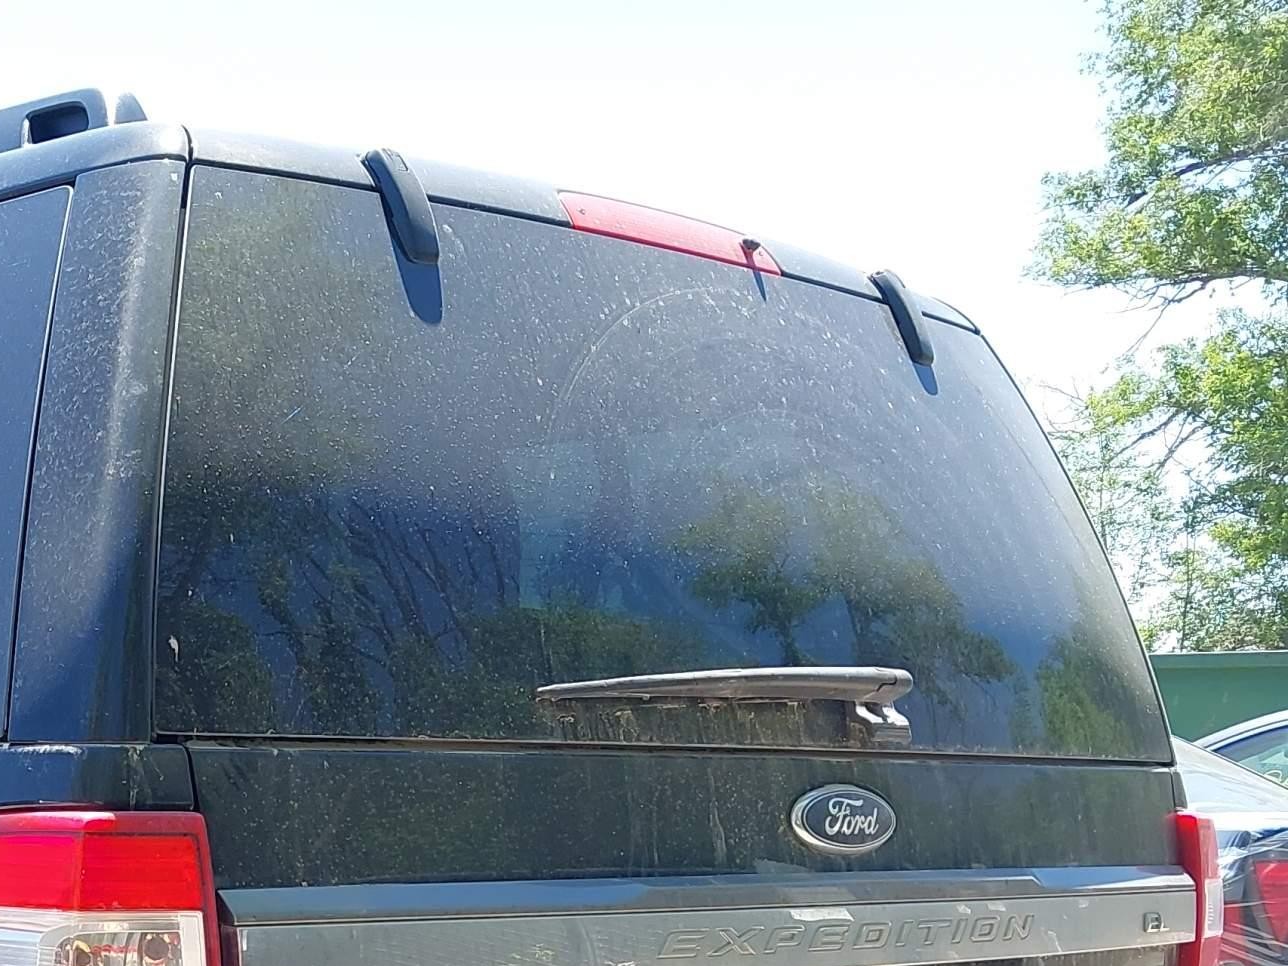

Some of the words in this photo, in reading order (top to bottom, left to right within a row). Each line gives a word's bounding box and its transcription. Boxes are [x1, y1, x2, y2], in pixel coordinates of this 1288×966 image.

[824, 797, 879, 836] Ford
[656, 914, 1035, 959] EXPEDITION
[1143, 911, 1170, 933] EL
